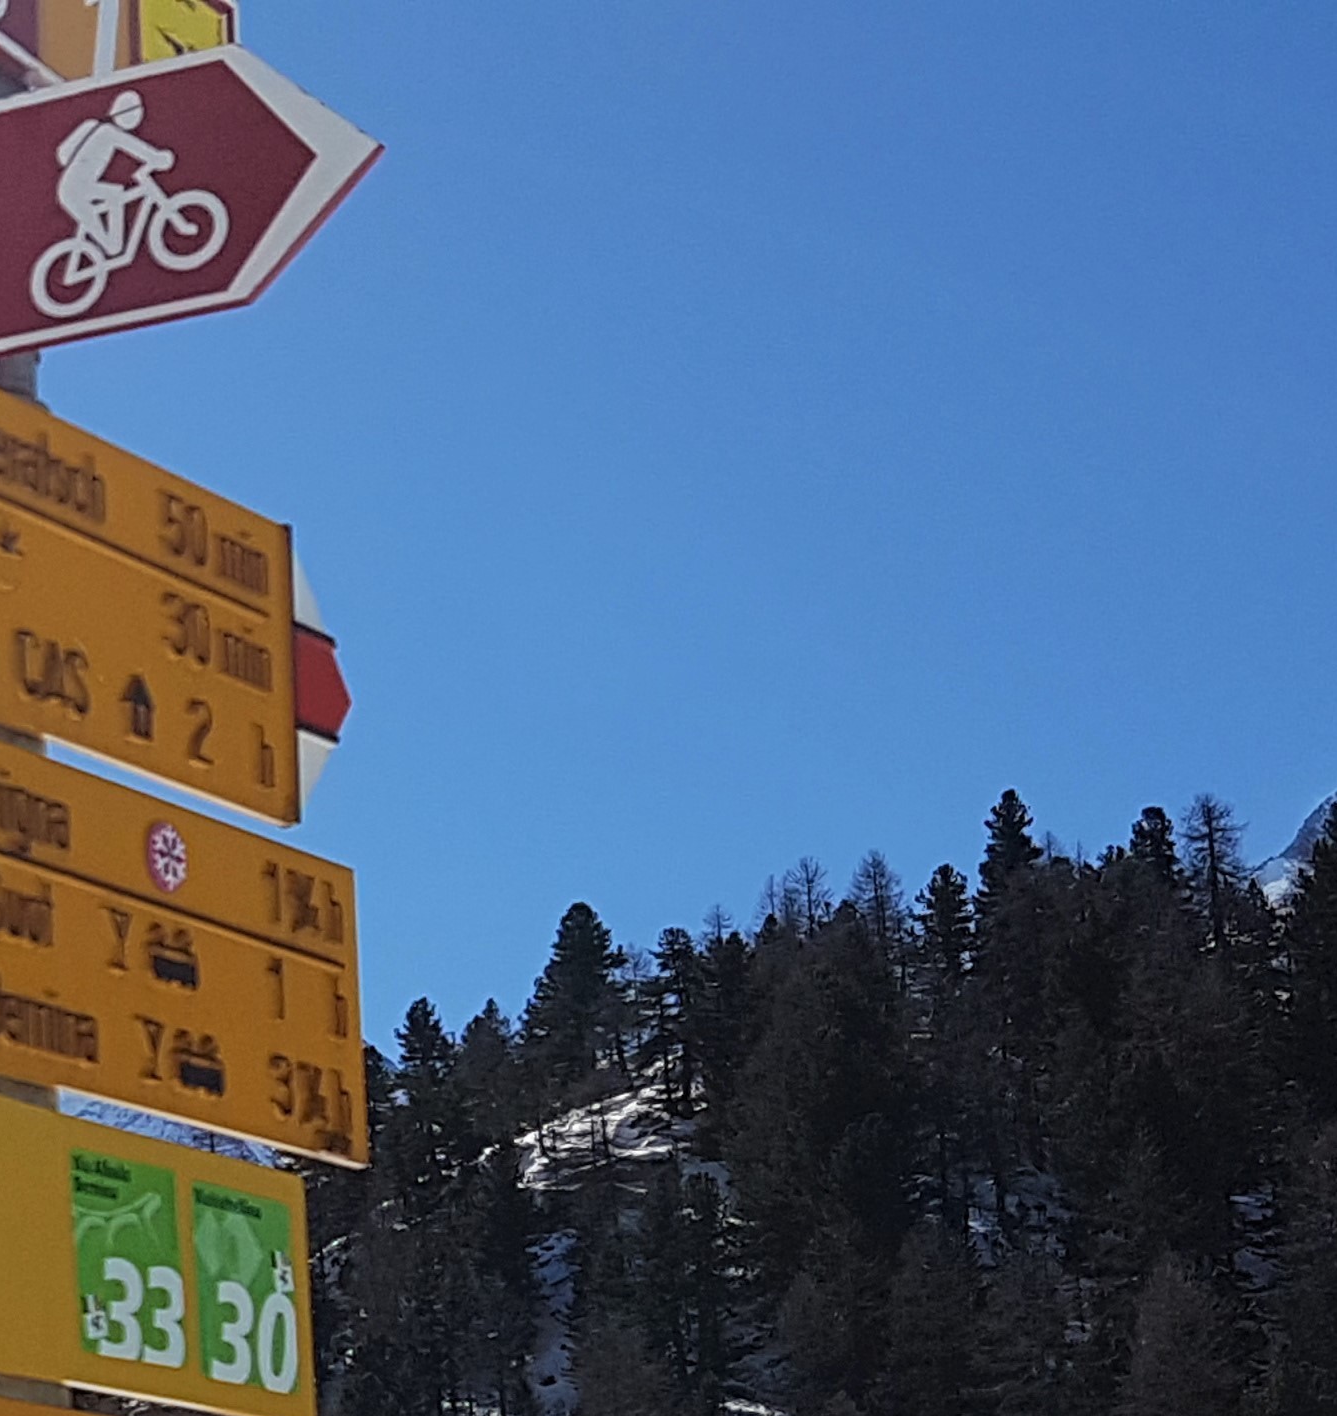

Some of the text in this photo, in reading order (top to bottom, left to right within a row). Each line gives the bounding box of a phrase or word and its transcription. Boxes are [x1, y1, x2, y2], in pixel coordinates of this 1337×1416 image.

[161, 490, 209, 568] 50
[161, 591, 212, 667] 30
[15, 627, 90, 716] CAS
[186, 697, 215, 766] 2
[253, 722, 276, 789] h
[267, 957, 287, 1021] 1
[330, 975, 350, 1039] h
[97, 1256, 186, 1369] 33
[211, 1280, 299, 1394] 30
